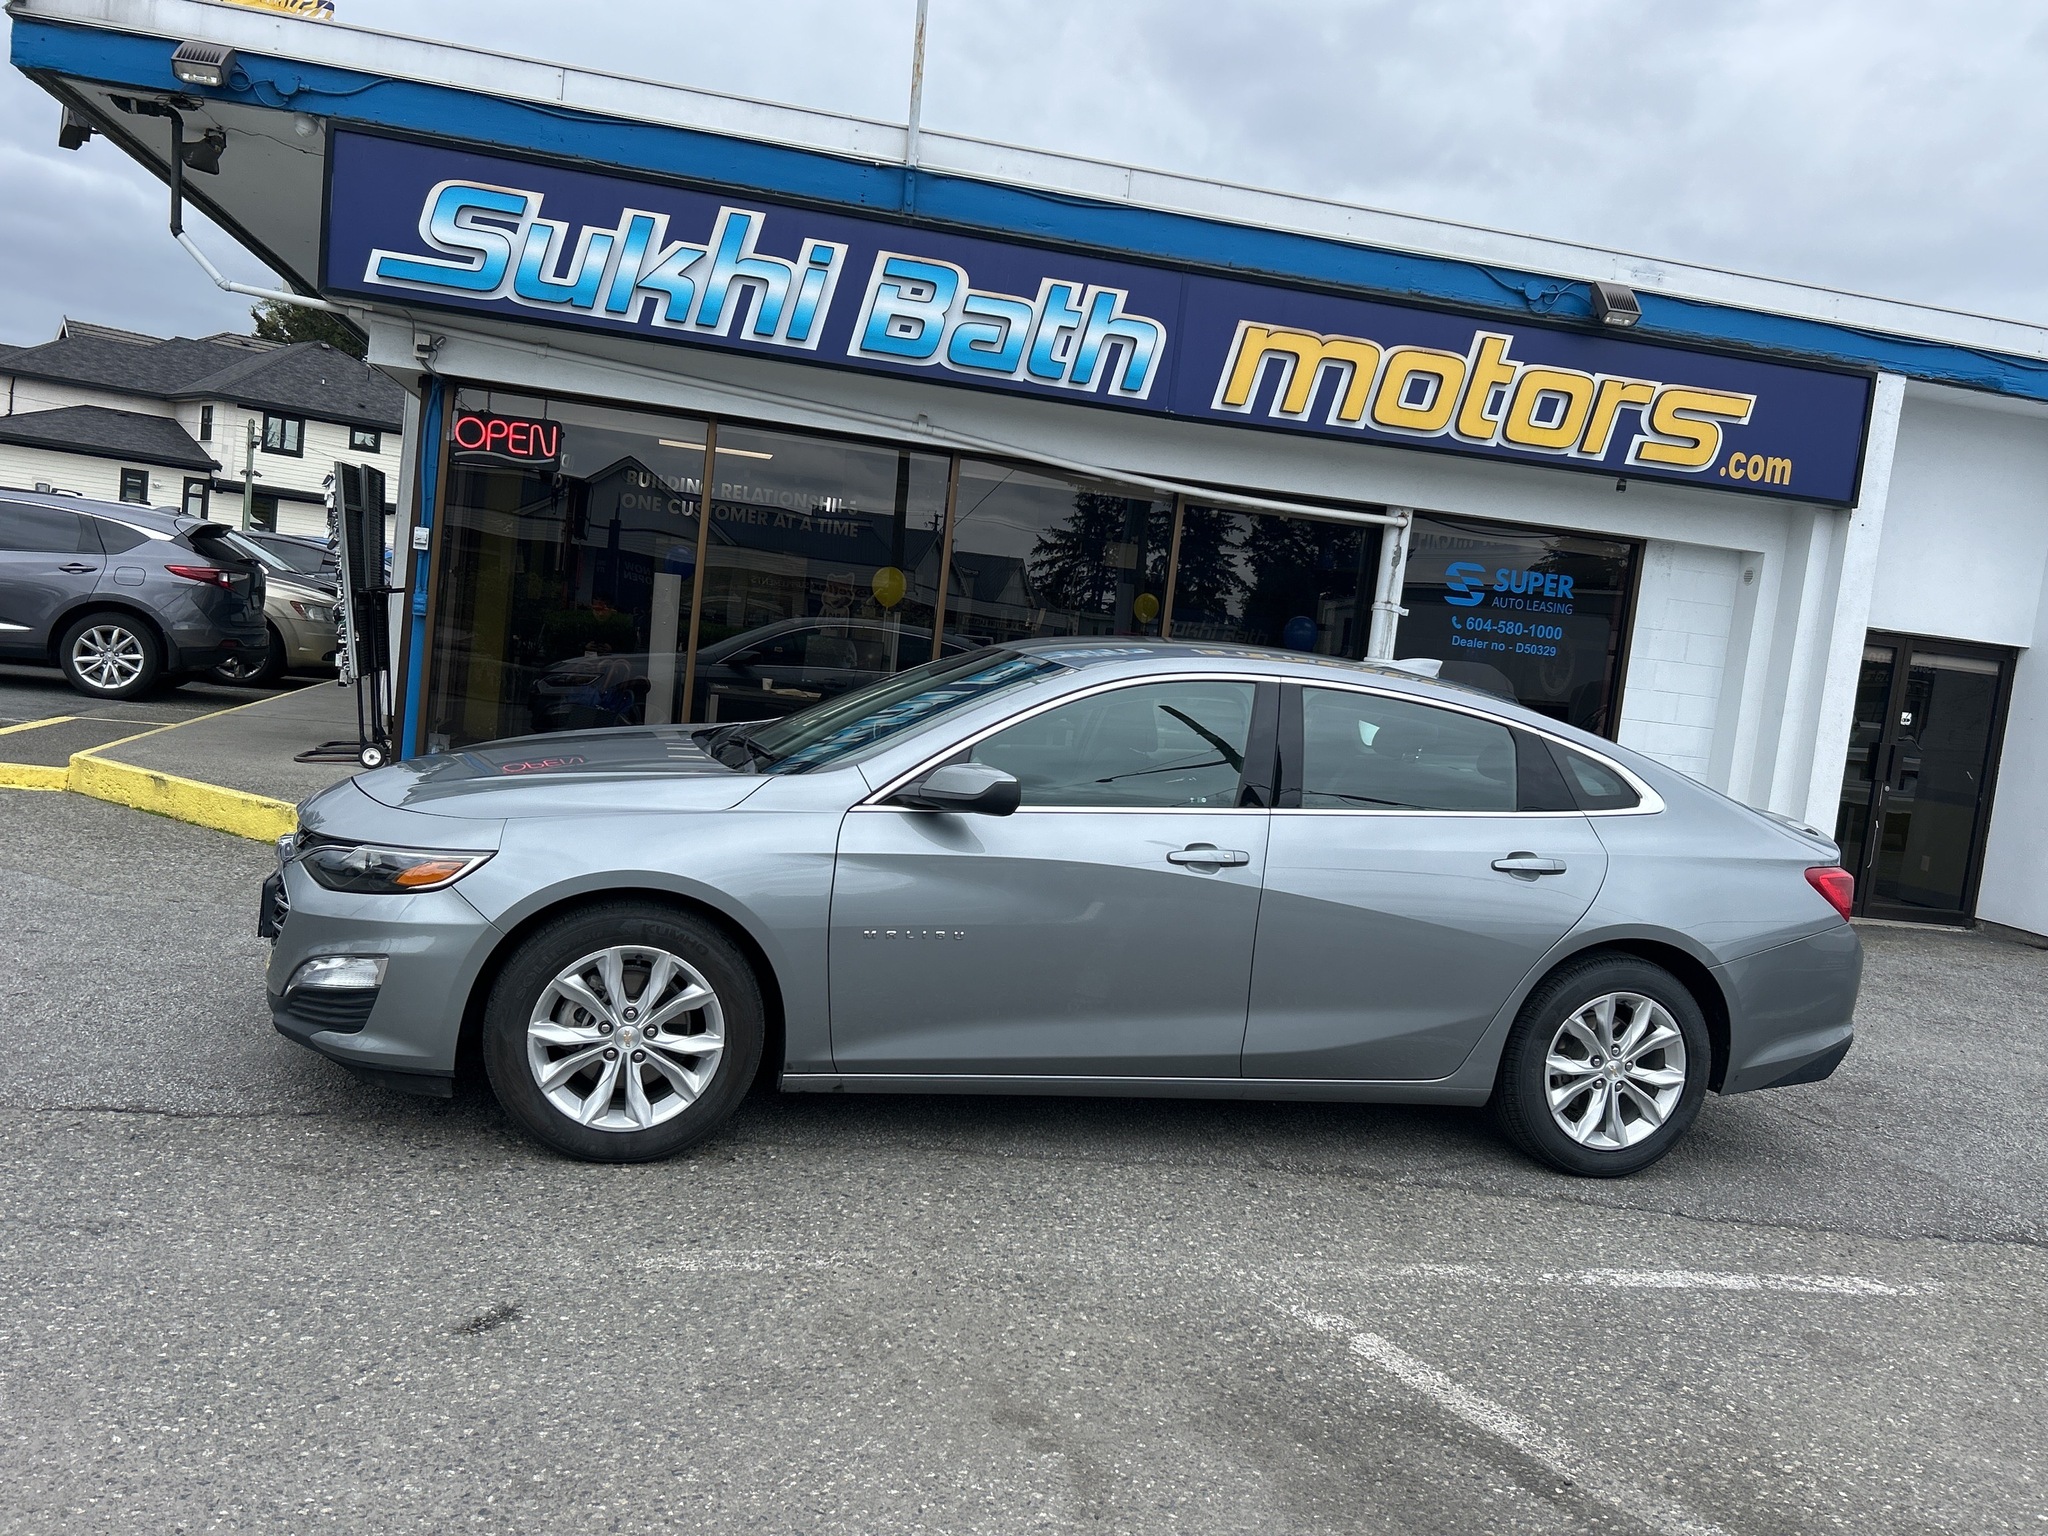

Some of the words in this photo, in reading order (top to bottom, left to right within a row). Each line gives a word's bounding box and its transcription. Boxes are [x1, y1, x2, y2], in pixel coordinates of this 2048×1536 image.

[364, 180, 848, 350] Sukhi
[847, 250, 1166, 399] Bath
[1210, 320, 1756, 473] motors
[1720, 449, 1792, 486] .com
[455, 416, 557, 457] OPEN
[626, 470, 715, 497] BUILDIN
[621, 492, 661, 512] ONE
[773, 513, 797, 529] AT
[800, 517, 813, 532] A
[818, 518, 858, 537] TIME
[1493, 568, 1574, 599] SUPER
[1492, 597, 1524, 610] AUTO
[1526, 600, 1573, 615] LEASING
[1466, 616, 1563, 640] 604-580-1000
[1451, 635, 1488, 649] Dealer
[1491, 642, 1505, 651] no
[1515, 642, 1557, 657] D50329
[863, 930, 965, 940] MALIBU
